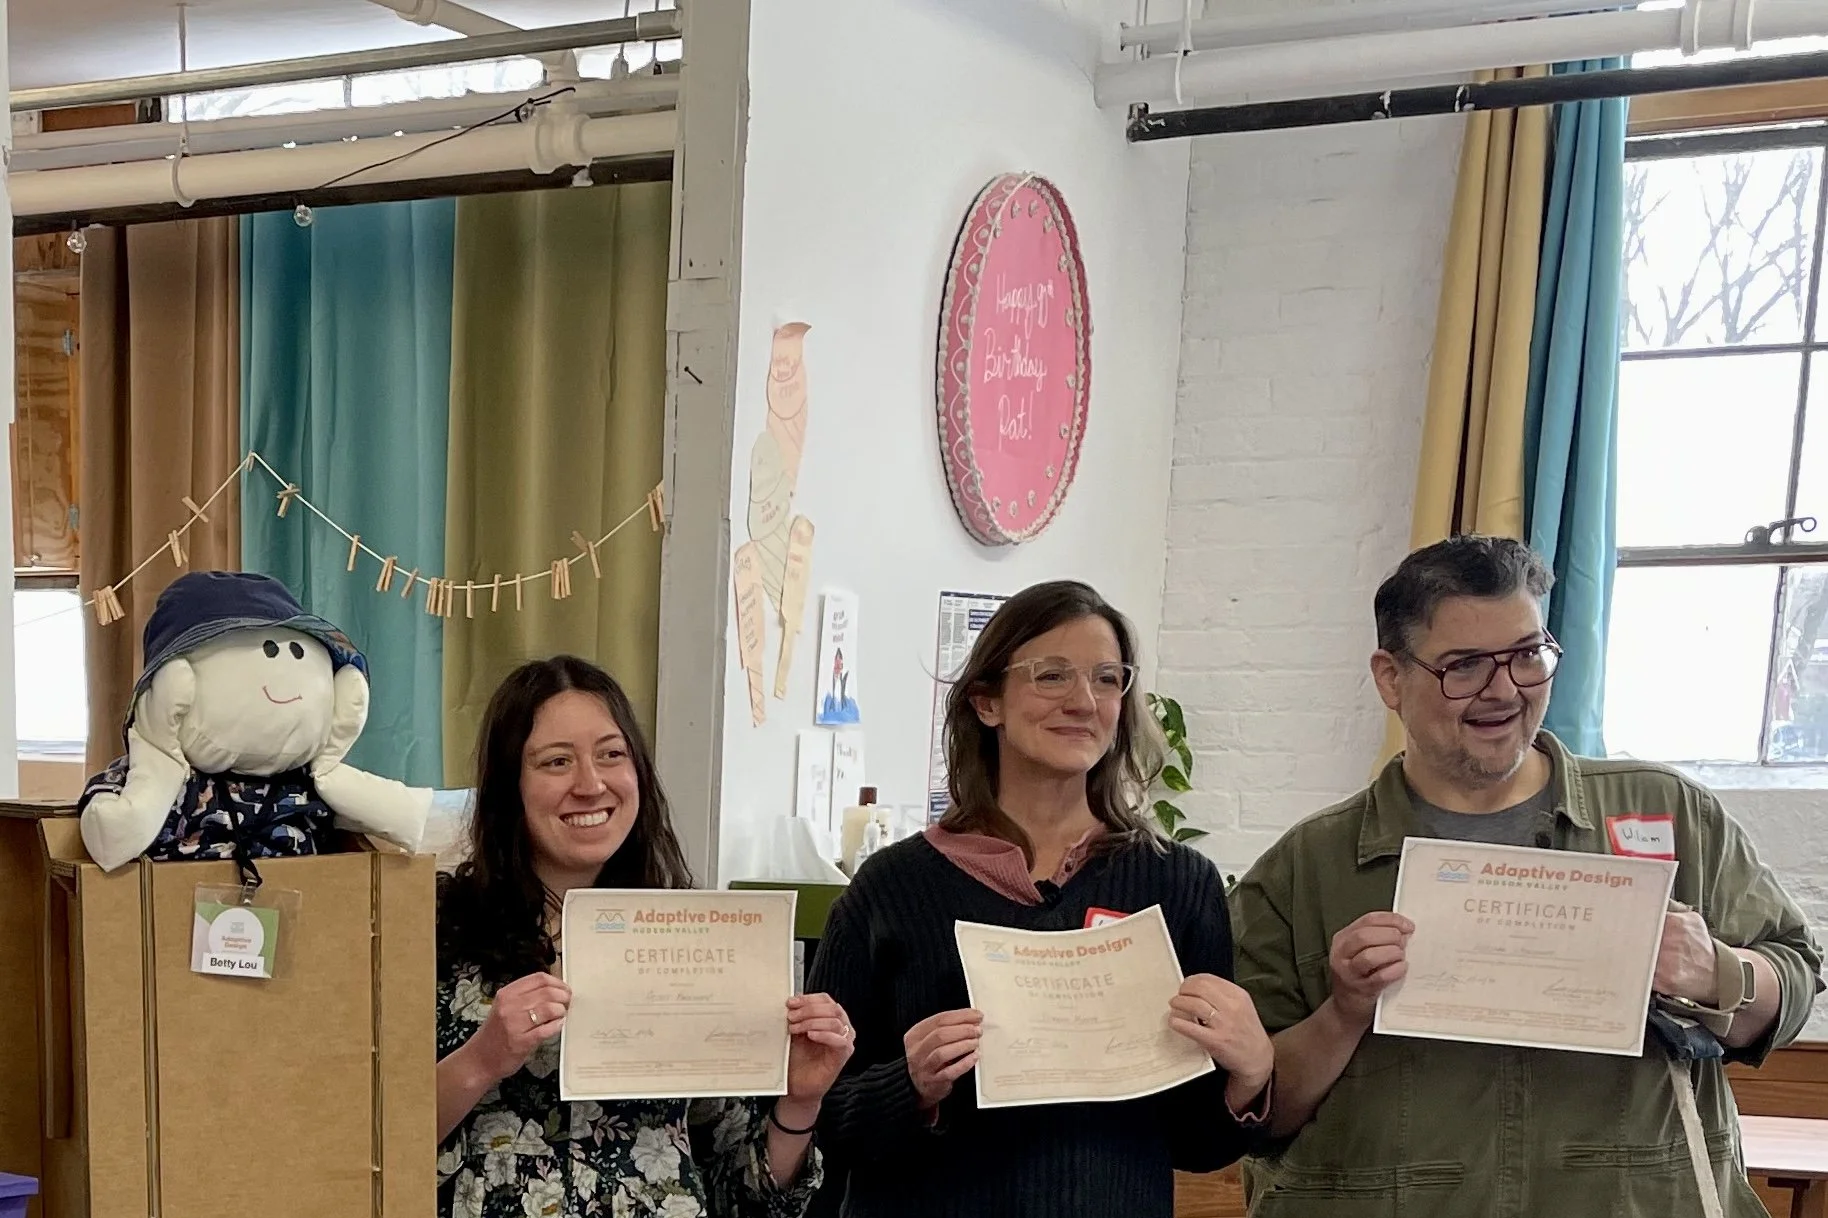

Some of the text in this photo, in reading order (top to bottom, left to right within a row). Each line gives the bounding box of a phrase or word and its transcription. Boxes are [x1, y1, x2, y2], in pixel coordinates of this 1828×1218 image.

[996, 272, 1037, 339] Happy
[984, 327, 1047, 392] Birthday
[998, 391, 1034, 452] Pat!
[1480, 862, 1633, 888] Adaptive Design
[633, 908, 763, 926] Adaptive Design
[1463, 898, 1594, 922] CERTIFICATE
[624, 948, 736, 964] CERTIFICATE
[1076, 936, 1133, 956] Design
[238, 959, 258, 970] Lou
[1014, 972, 1115, 991] CERTIFICATE
